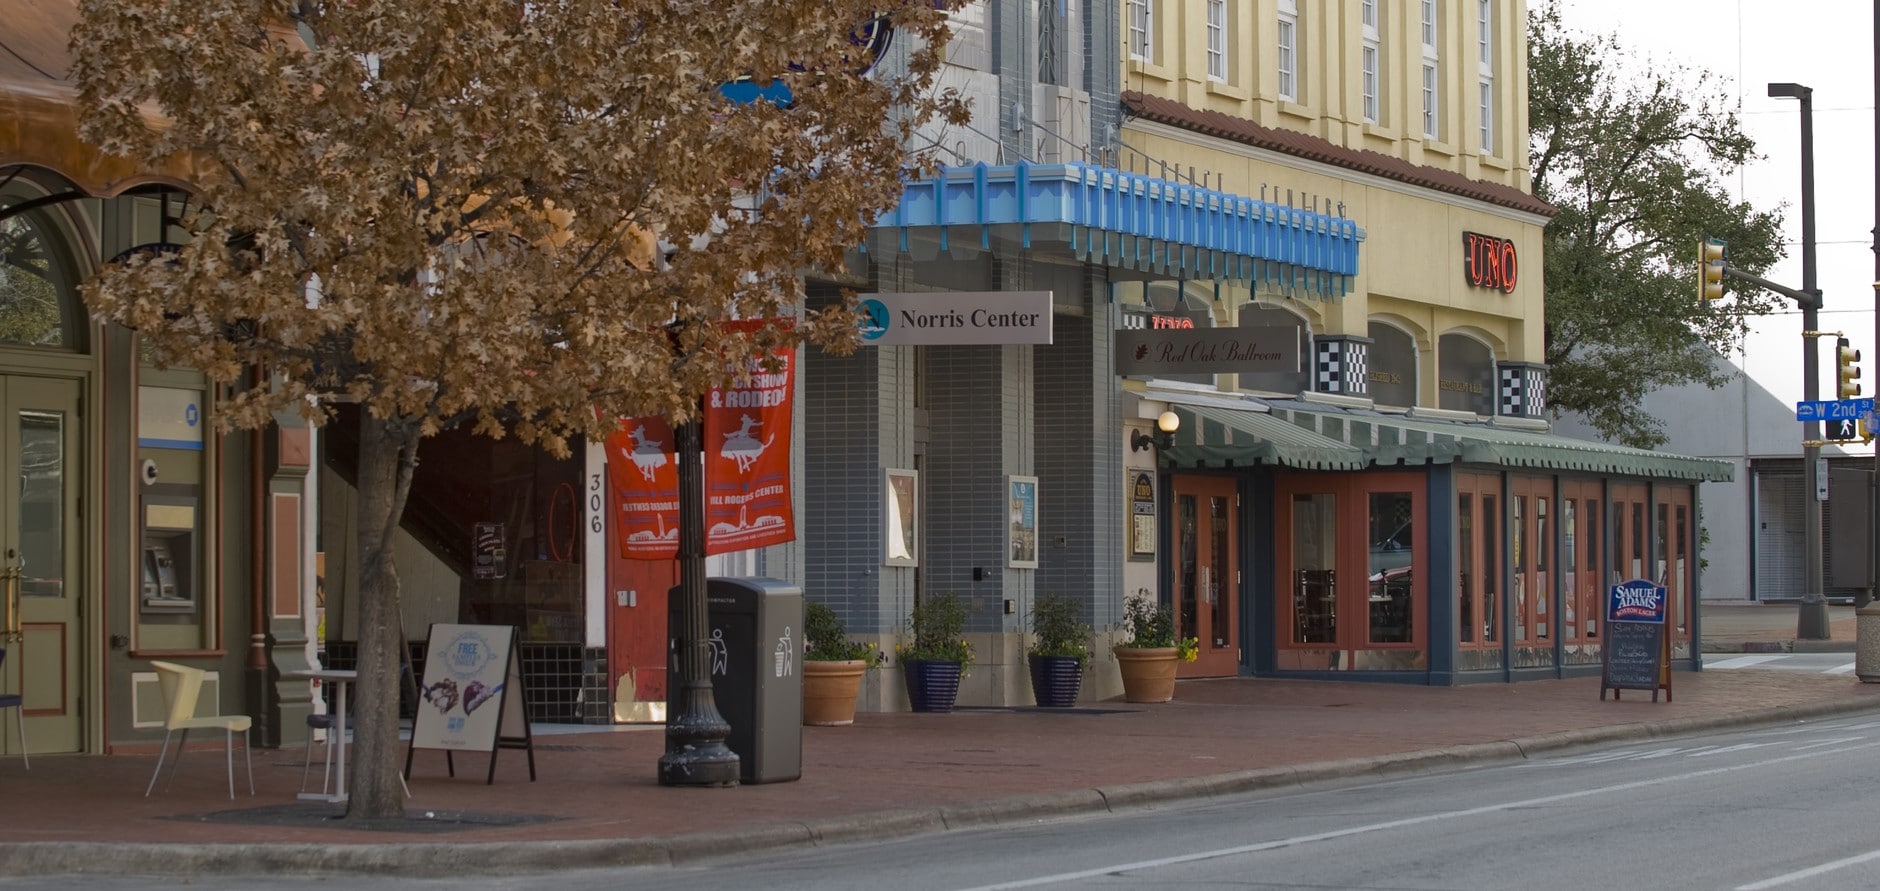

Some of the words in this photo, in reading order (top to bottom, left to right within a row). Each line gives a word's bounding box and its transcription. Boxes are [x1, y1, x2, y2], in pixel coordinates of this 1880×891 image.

[1465, 232, 1517, 294] UNO
[900, 309, 964, 329] Norris
[970, 308, 1040, 328] Center
[1154, 342, 1188, 363] Red
[1190, 341, 1217, 362] Oak
[1220, 339, 1282, 361] Ballroom
[711, 390, 723, 408] &
[725, 386, 787, 408] RODEO!
[1815, 403, 1826, 417] W
[1832, 402, 1856, 417] 2nd
[1861, 400, 1870, 409] St
[754, 484, 784, 498] CENTER
[590, 473, 602, 534] 306
[1615, 585, 1661, 599] SAMUEL
[1618, 597, 1657, 609] ADAMS
[1616, 608, 1638, 617] BOSTON
[1638, 608, 1657, 616] LAGER
[457, 643, 478, 655] FREE
